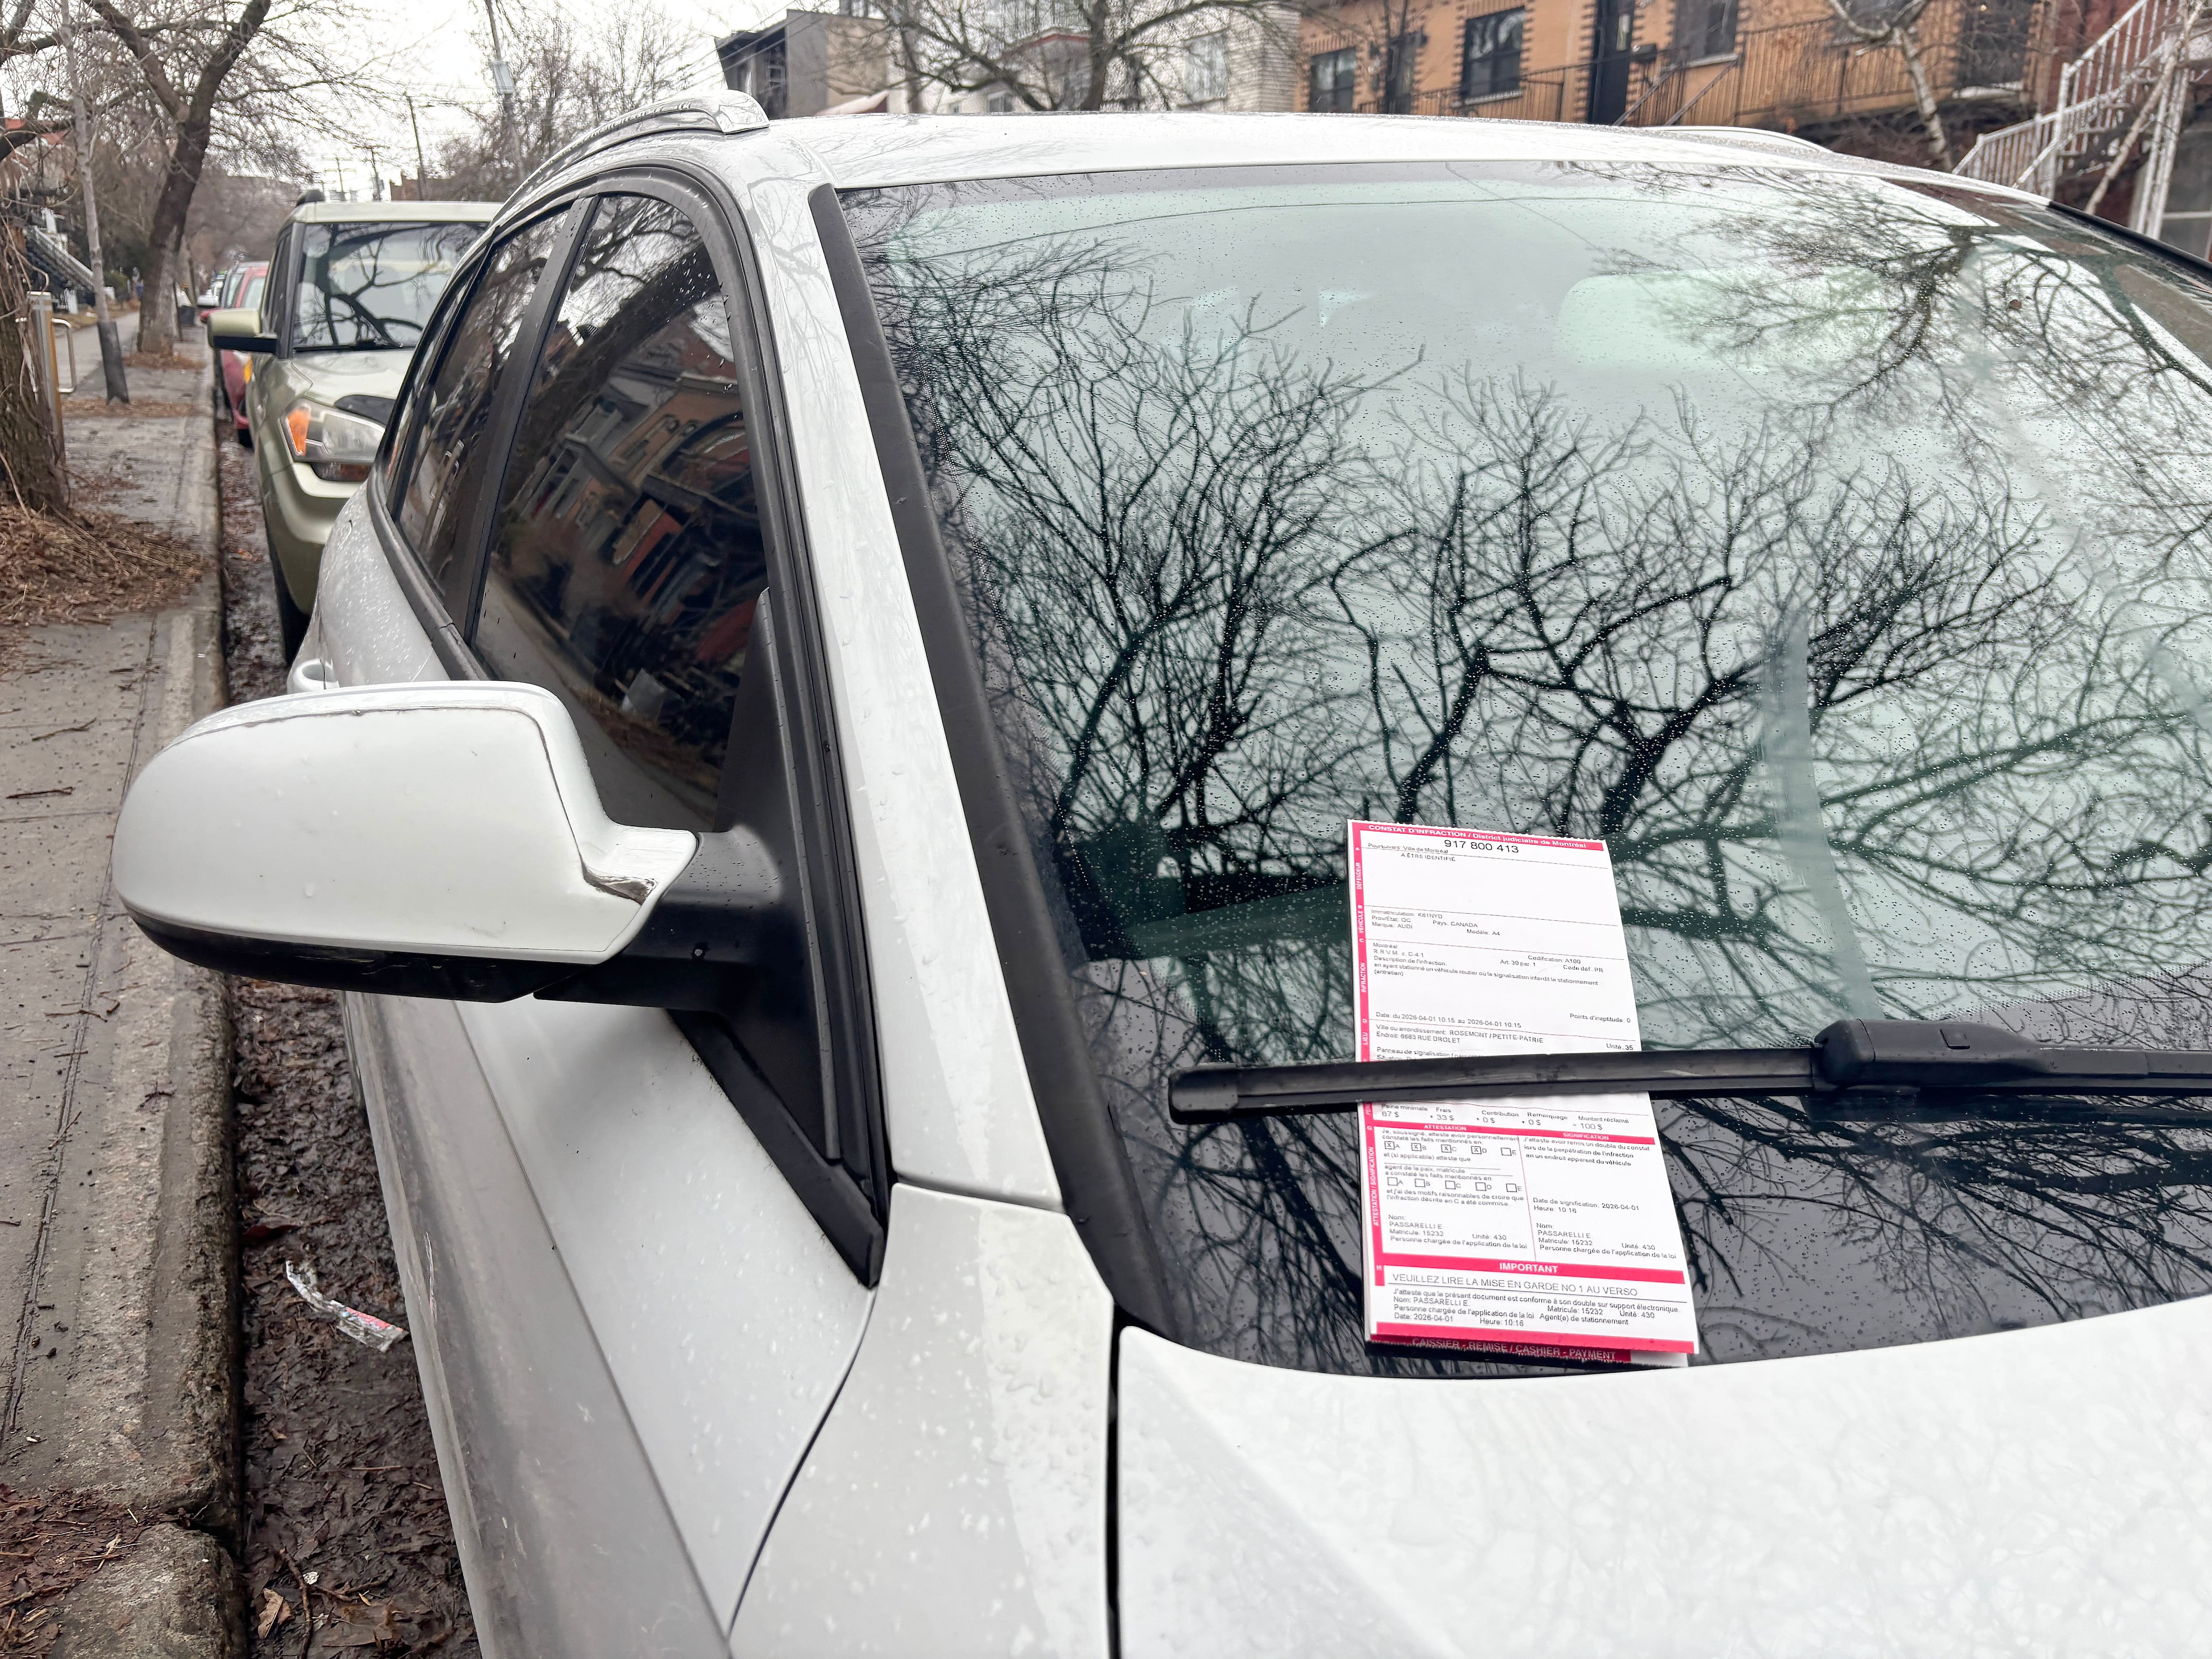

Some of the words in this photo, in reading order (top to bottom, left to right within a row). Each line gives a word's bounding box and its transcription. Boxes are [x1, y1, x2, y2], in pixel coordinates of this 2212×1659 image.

[1408, 828, 1466, 837] D'INFRACTION
[1444, 839, 1466, 848] 917
[1470, 842, 1493, 850] 800
[1496, 844, 1519, 853] 413
[1449, 1029, 1488, 1038] ROSEMONT
[1492, 1033, 1543, 1043] PETITE-PATRIE
[1499, 1262, 1558, 1273] IMPORTANT
[1392, 1273, 1440, 1283] VEUILLEZ
[1481, 1279, 1505, 1287] MISE
[1523, 1281, 1559, 1290] GARDE
[1602, 1286, 1637, 1295] VERSO
[1413, 1297, 1461, 1306] PASSARELLI
[1428, 1306, 1456, 1315] chargée
[1467, 1309, 1507, 1317] l'application
[1636, 1304, 1681, 1312] électronique.
[1413, 1313, 1454, 1321] 2026-04-01
[1539, 1313, 1569, 1322] Agent(e)
[1569, 1348, 1616, 1359] PAYMENT
